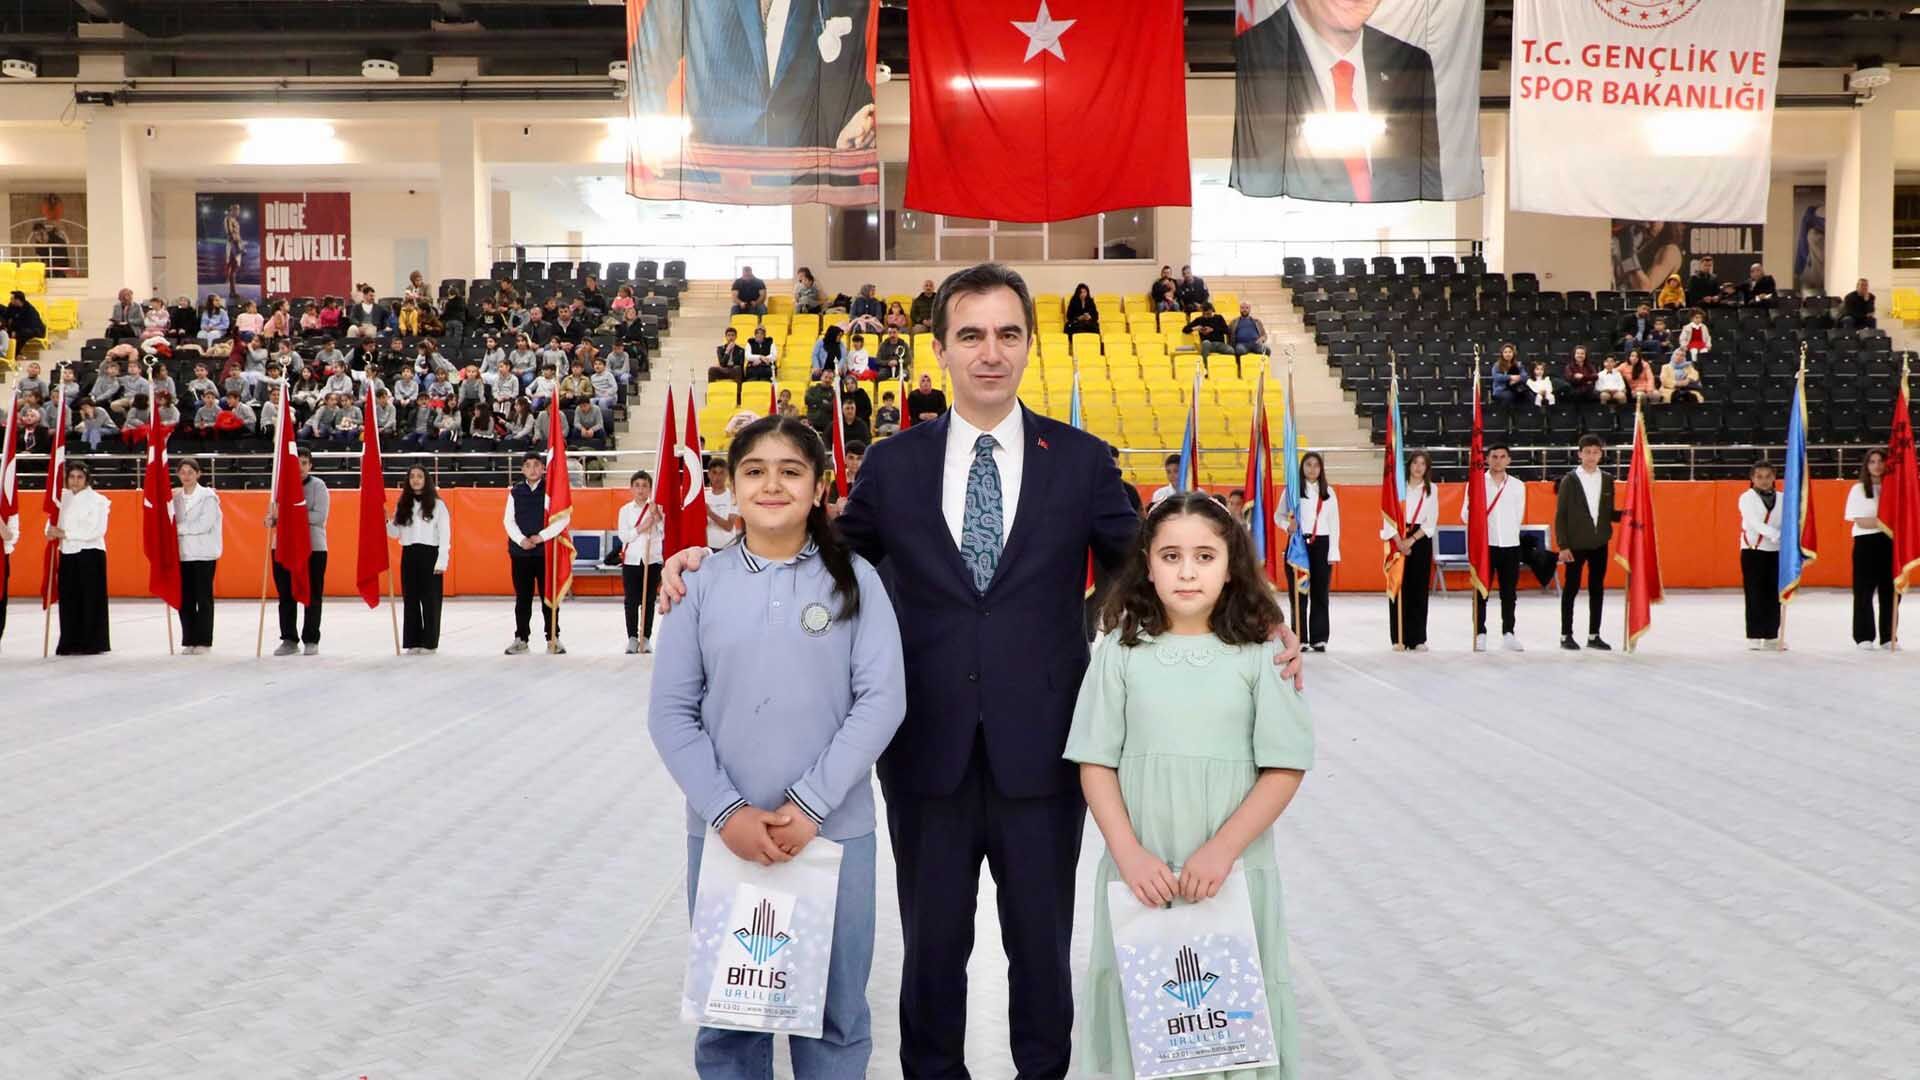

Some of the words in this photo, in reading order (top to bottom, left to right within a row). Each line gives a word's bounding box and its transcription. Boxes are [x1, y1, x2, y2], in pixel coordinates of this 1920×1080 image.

[1521, 40, 1571, 65] T.C.
[1581, 43, 1718, 77] GENÇLİK
[1730, 50, 1766, 76] VE
[1520, 76, 1593, 103] SPOR
[1602, 81, 1765, 112] BAKANLIĞI
[727, 963, 787, 990] BİTLİS
[1167, 1008, 1228, 1036] BİTLİS
